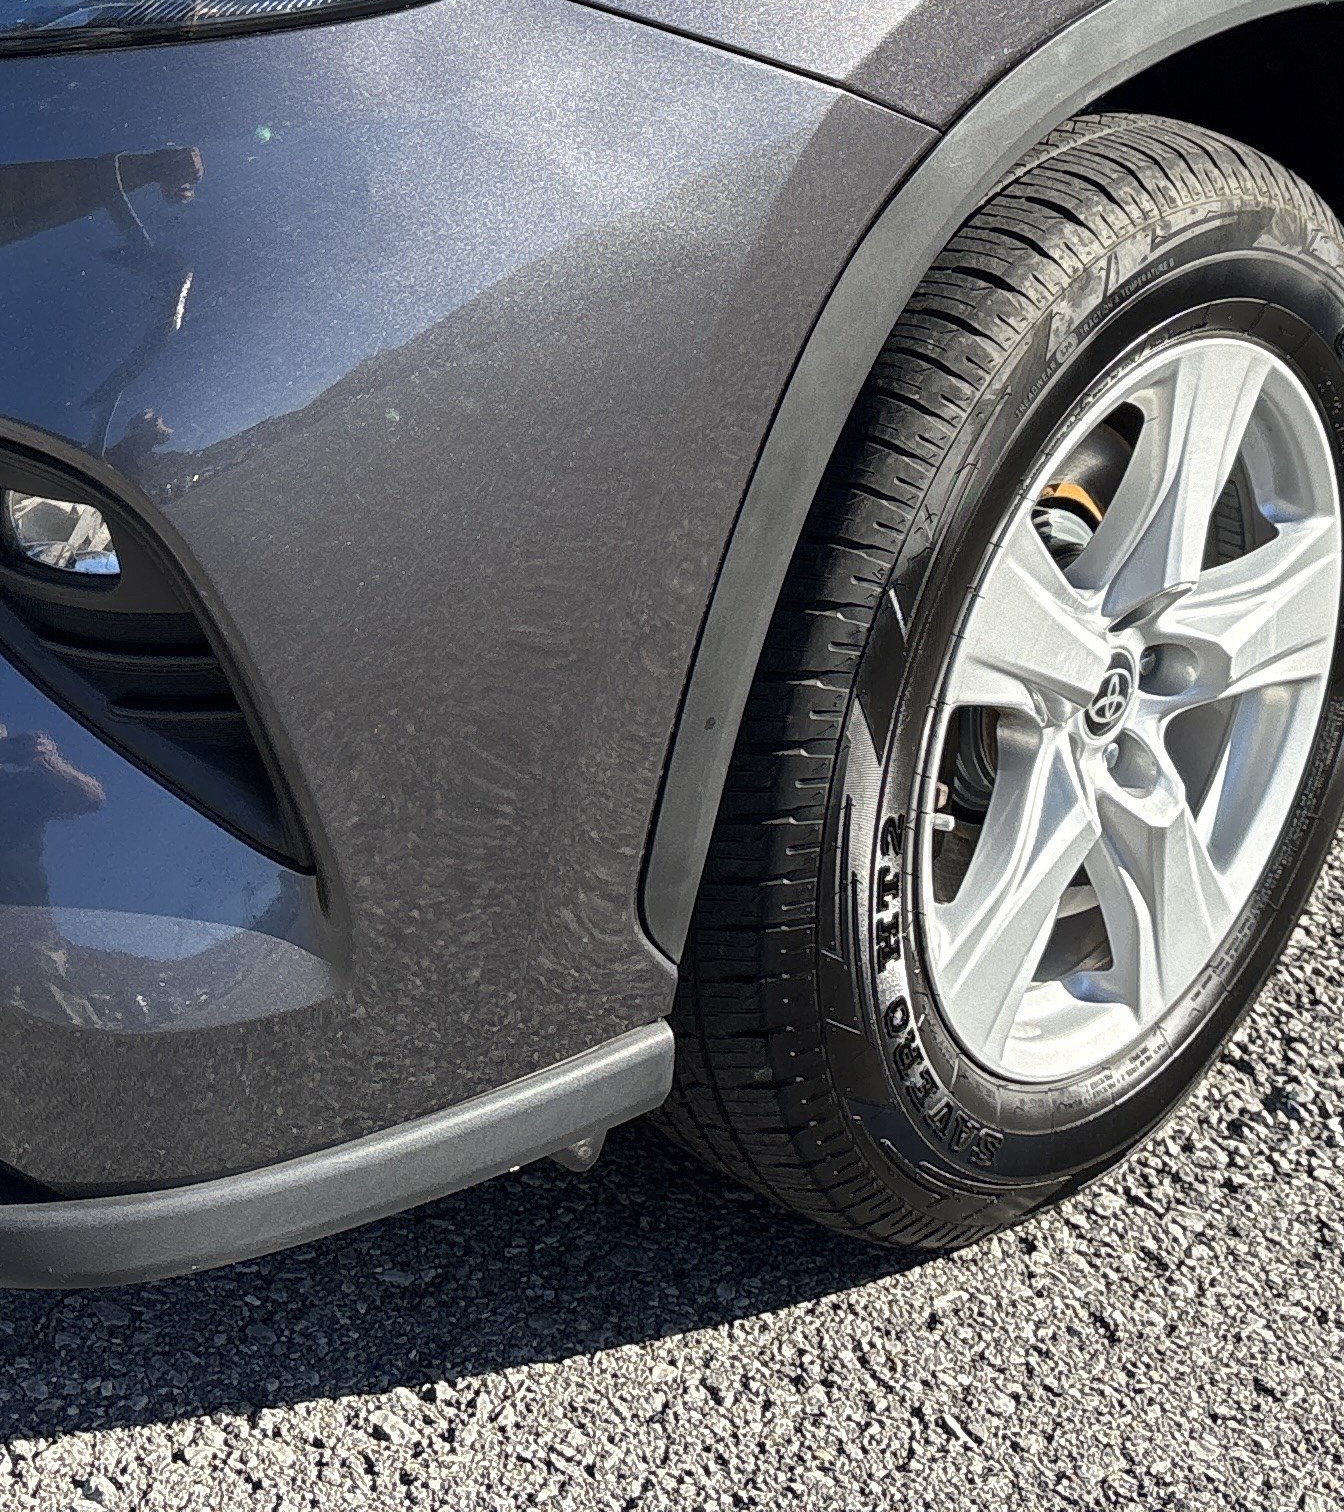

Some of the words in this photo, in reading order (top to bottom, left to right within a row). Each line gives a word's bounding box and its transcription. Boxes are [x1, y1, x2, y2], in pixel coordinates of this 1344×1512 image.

[1014, 360, 1057, 419] TREADWEAR
[1121, 262, 1169, 297] TEMPERATURE
[875, 814, 906, 975] HT2
[883, 994, 1004, 1167] SAVERO
